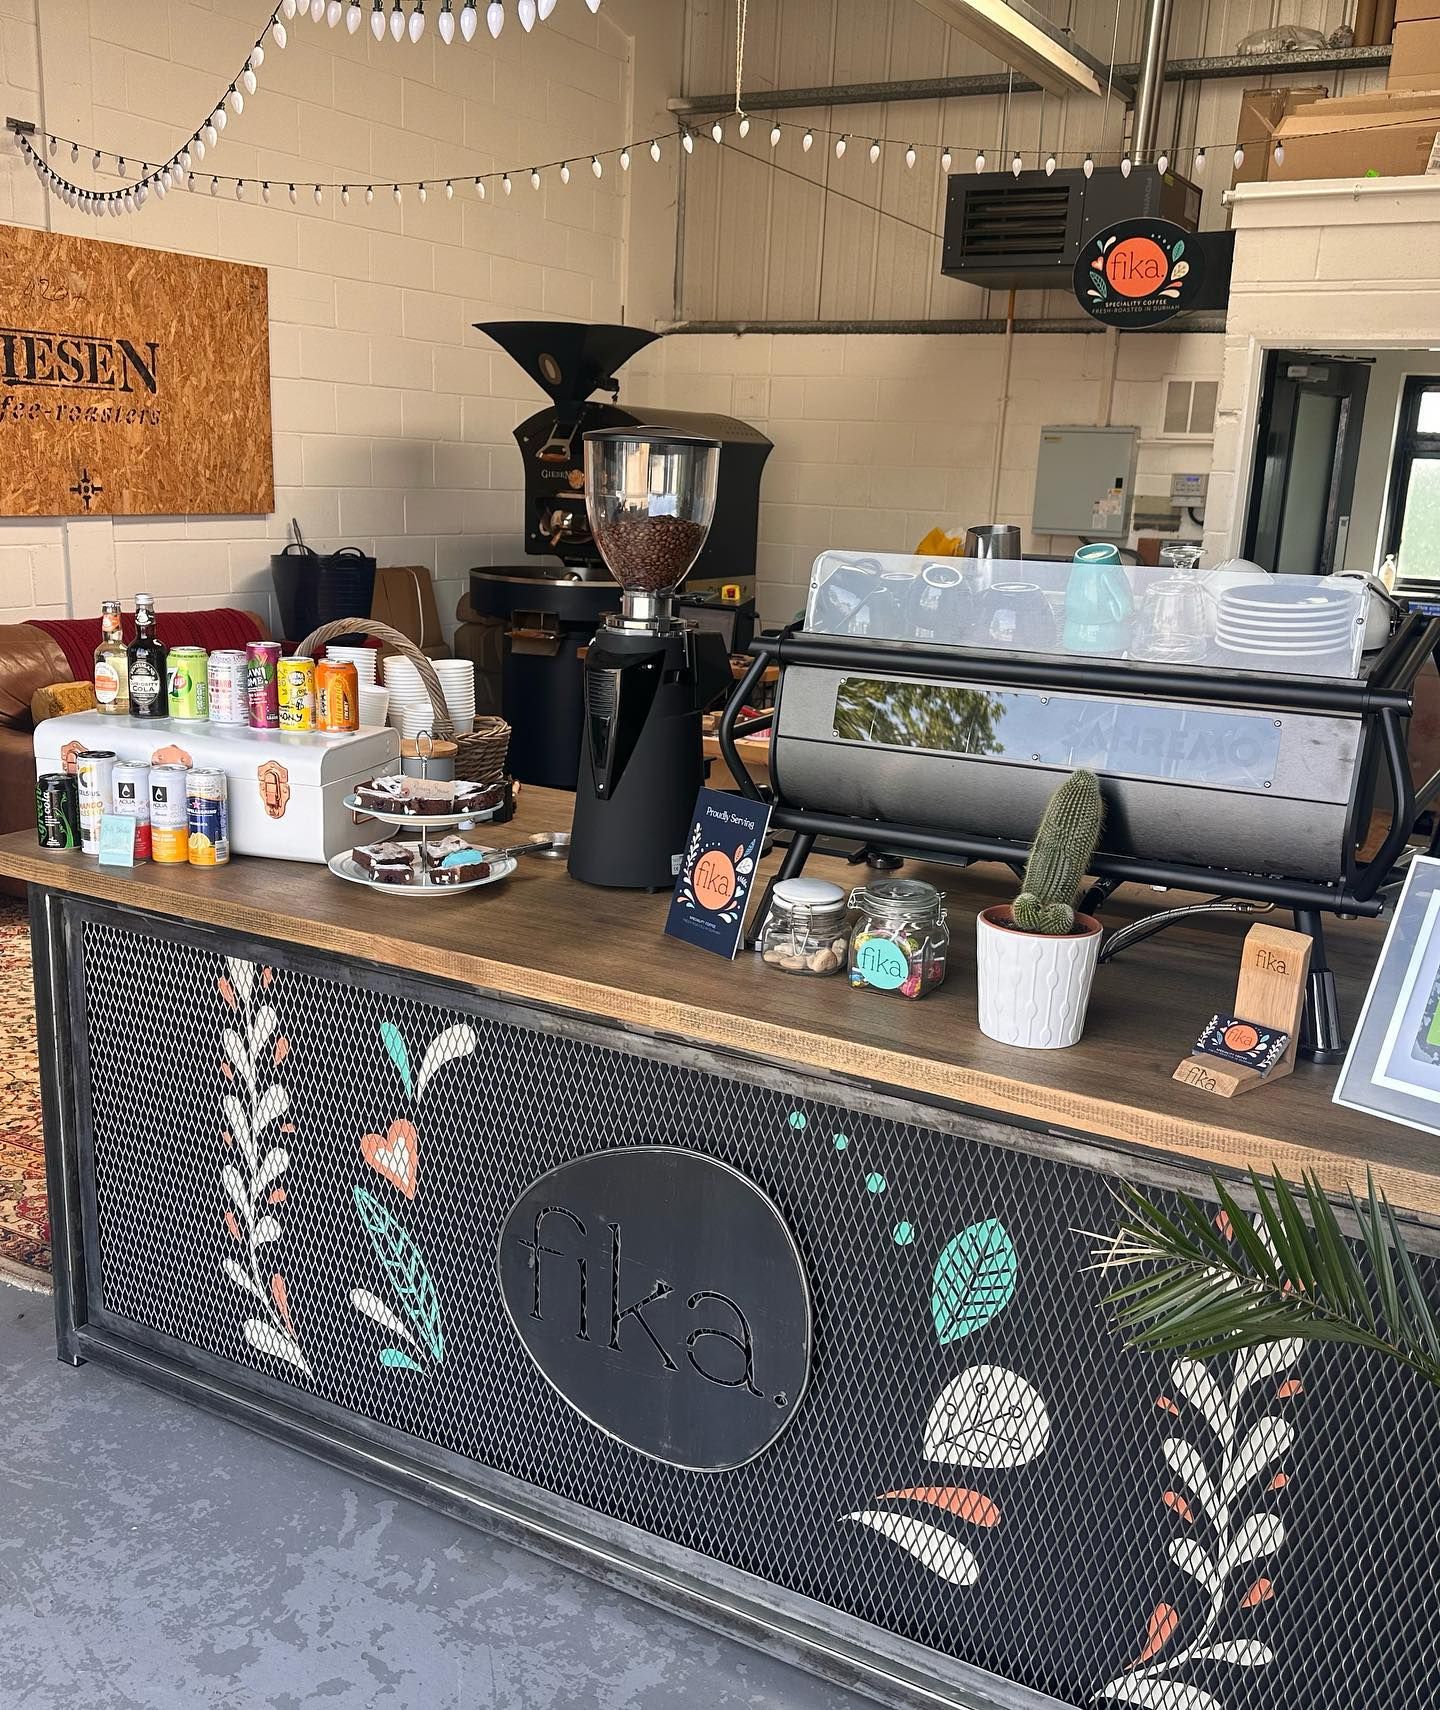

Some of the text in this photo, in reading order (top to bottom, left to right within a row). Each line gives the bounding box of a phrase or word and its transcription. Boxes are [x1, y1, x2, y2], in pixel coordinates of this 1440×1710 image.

[1110, 251, 1165, 281] fika.
[1105, 300, 1141, 308] SPECIALITY
[42, 791, 51, 815] cola
[706, 806, 755, 830] Proudly Serving
[696, 860, 731, 898] fika.
[860, 946, 906, 979] fika.
[1255, 949, 1290, 976] fika.
[1183, 1066, 1217, 1093] fika.
[517, 1206, 788, 1408] fika.
